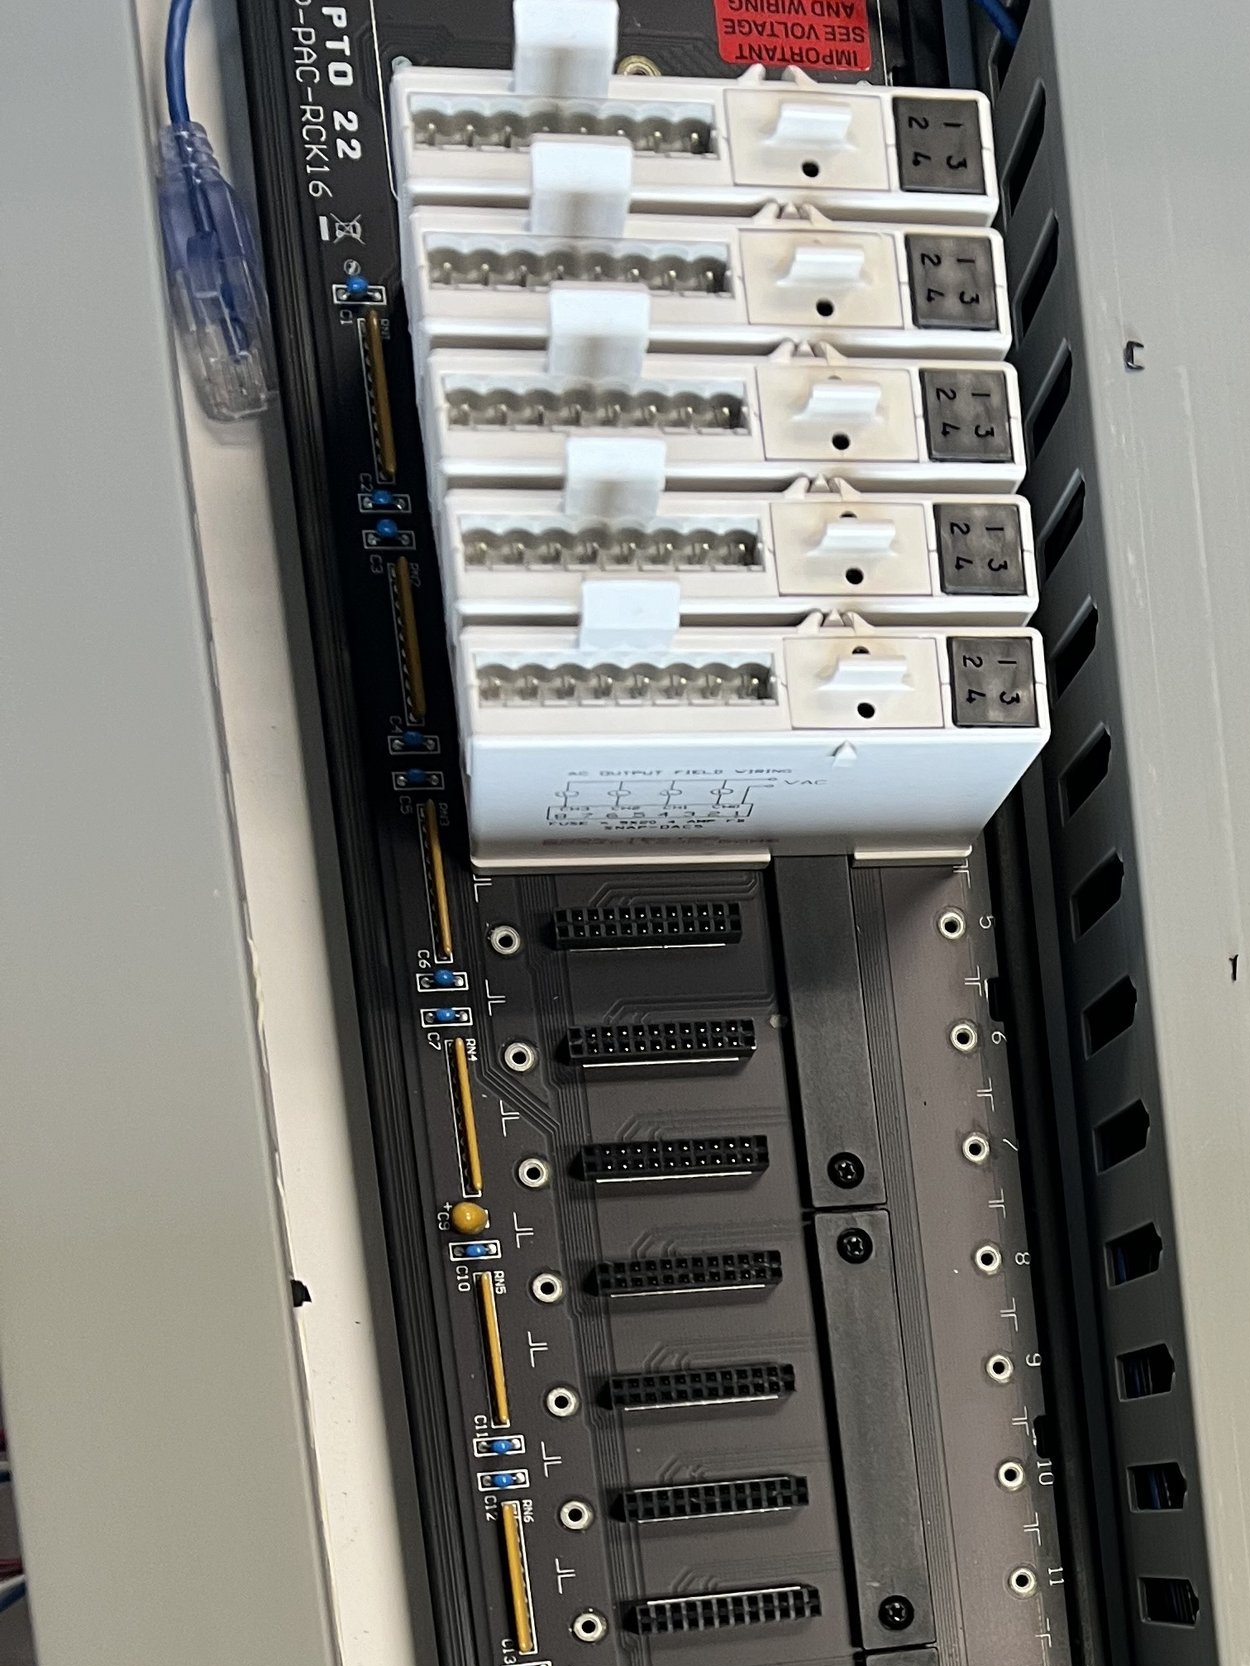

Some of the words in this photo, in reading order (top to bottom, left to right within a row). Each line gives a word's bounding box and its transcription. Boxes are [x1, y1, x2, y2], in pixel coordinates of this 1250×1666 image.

[729, 0, 801, 15] WIRING
[807, 1, 854, 18] AND
[724, 18, 820, 41] VOLTAGE
[825, 24, 865, 42] SEE
[322, 6, 354, 87] PTO
[735, 43, 858, 67] IMPORTANT
[291, 0, 332, 198] -PAC-RCK16
[908, 116, 929, 129] 2
[333, 110, 361, 160] 22
[912, 152, 931, 166] 4
[946, 156, 967, 169] 3
[921, 253, 941, 266] 2
[927, 288, 944, 302] 4
[959, 291, 979, 306] 3
[936, 388, 956, 402] 2
[941, 422, 960, 437] 4
[975, 425, 994, 439] 3
[950, 522, 970, 535] 2
[955, 556, 973, 570] 4
[988, 558, 1008, 572] 3
[963, 655, 983, 668] 2
[966, 689, 986, 704] 4
[999, 691, 1020, 705] 3
[979, 915, 994, 929] 5
[418, 950, 430, 968] C6
[427, 1032, 441, 1050] C7
[991, 1031, 1007, 1045] 6
[465, 1038, 477, 1061] RN4
[438, 1212, 450, 1231] C9
[1015, 1252, 1031, 1265] 8
[456, 1265, 470, 1292] C10
[493, 1270, 506, 1294] RN5
[1025, 1353, 1042, 1367] 9
[474, 1414, 489, 1438] C11
[1036, 1459, 1054, 1486] 10
[485, 1495, 497, 1521] C12
[522, 1499, 534, 1523] RN6
[1048, 1566, 1064, 1586] 11
[502, 1638, 516, 1664] C13
